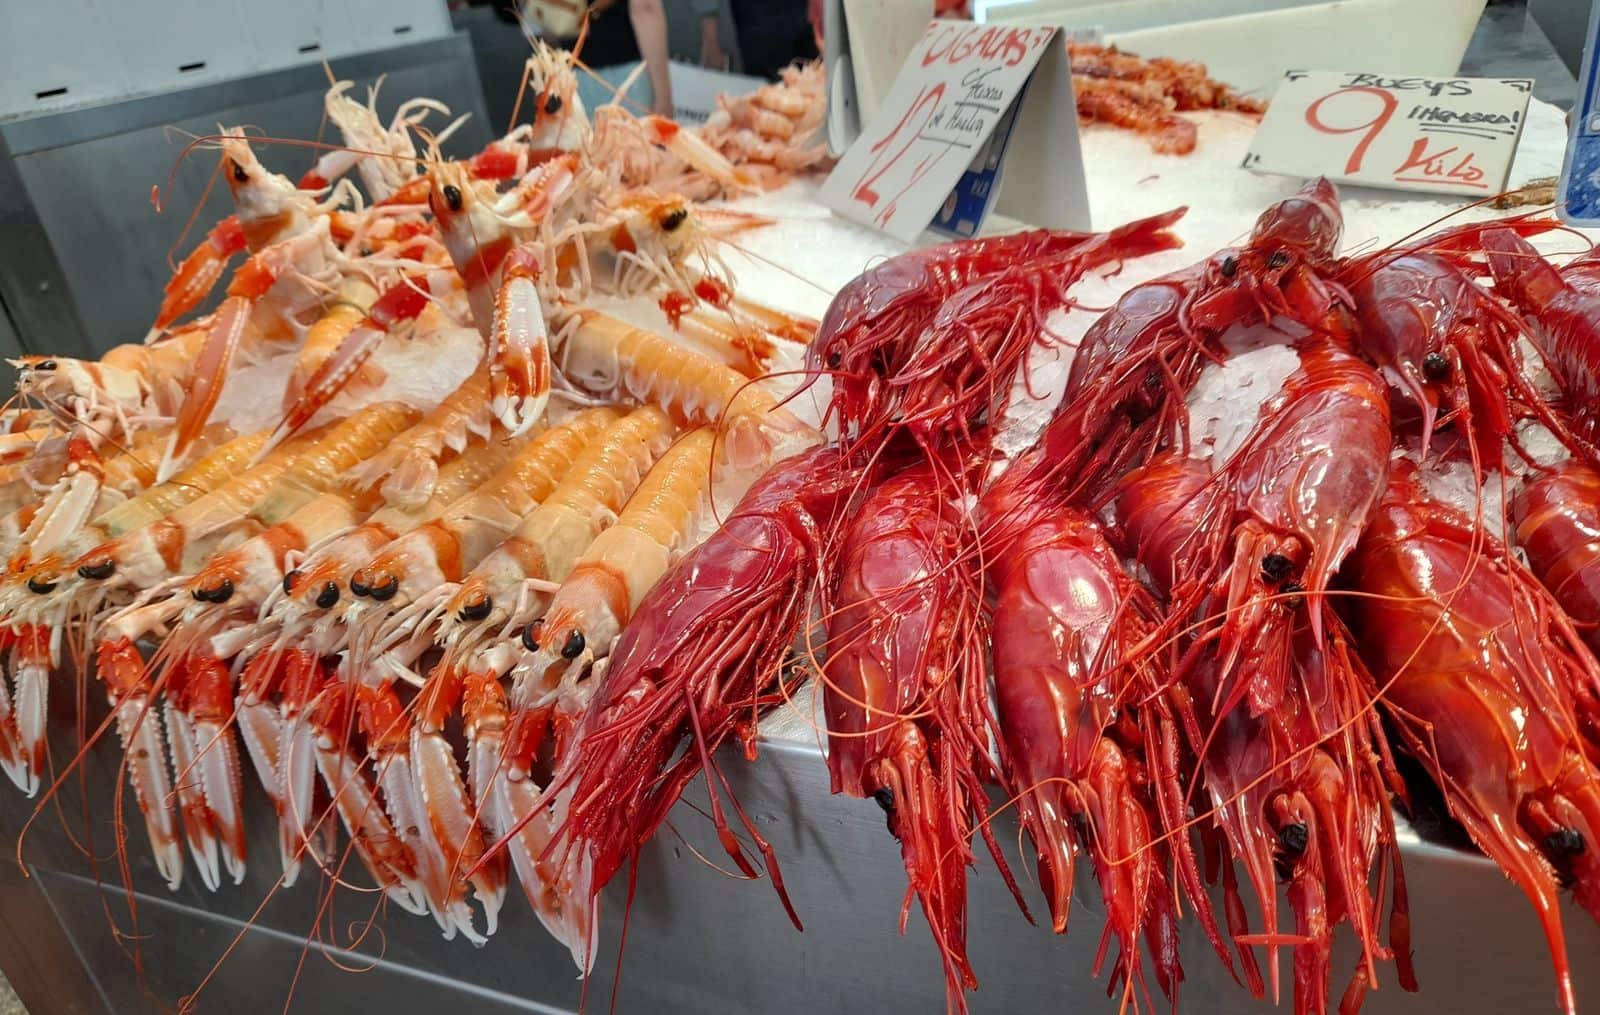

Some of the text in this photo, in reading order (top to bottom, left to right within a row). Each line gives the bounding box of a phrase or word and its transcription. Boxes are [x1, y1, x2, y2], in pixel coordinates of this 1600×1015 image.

[921, 25, 1033, 68] CIGALAS
[1340, 73, 1473, 96] BUEYS
[1304, 87, 1399, 175] 9
